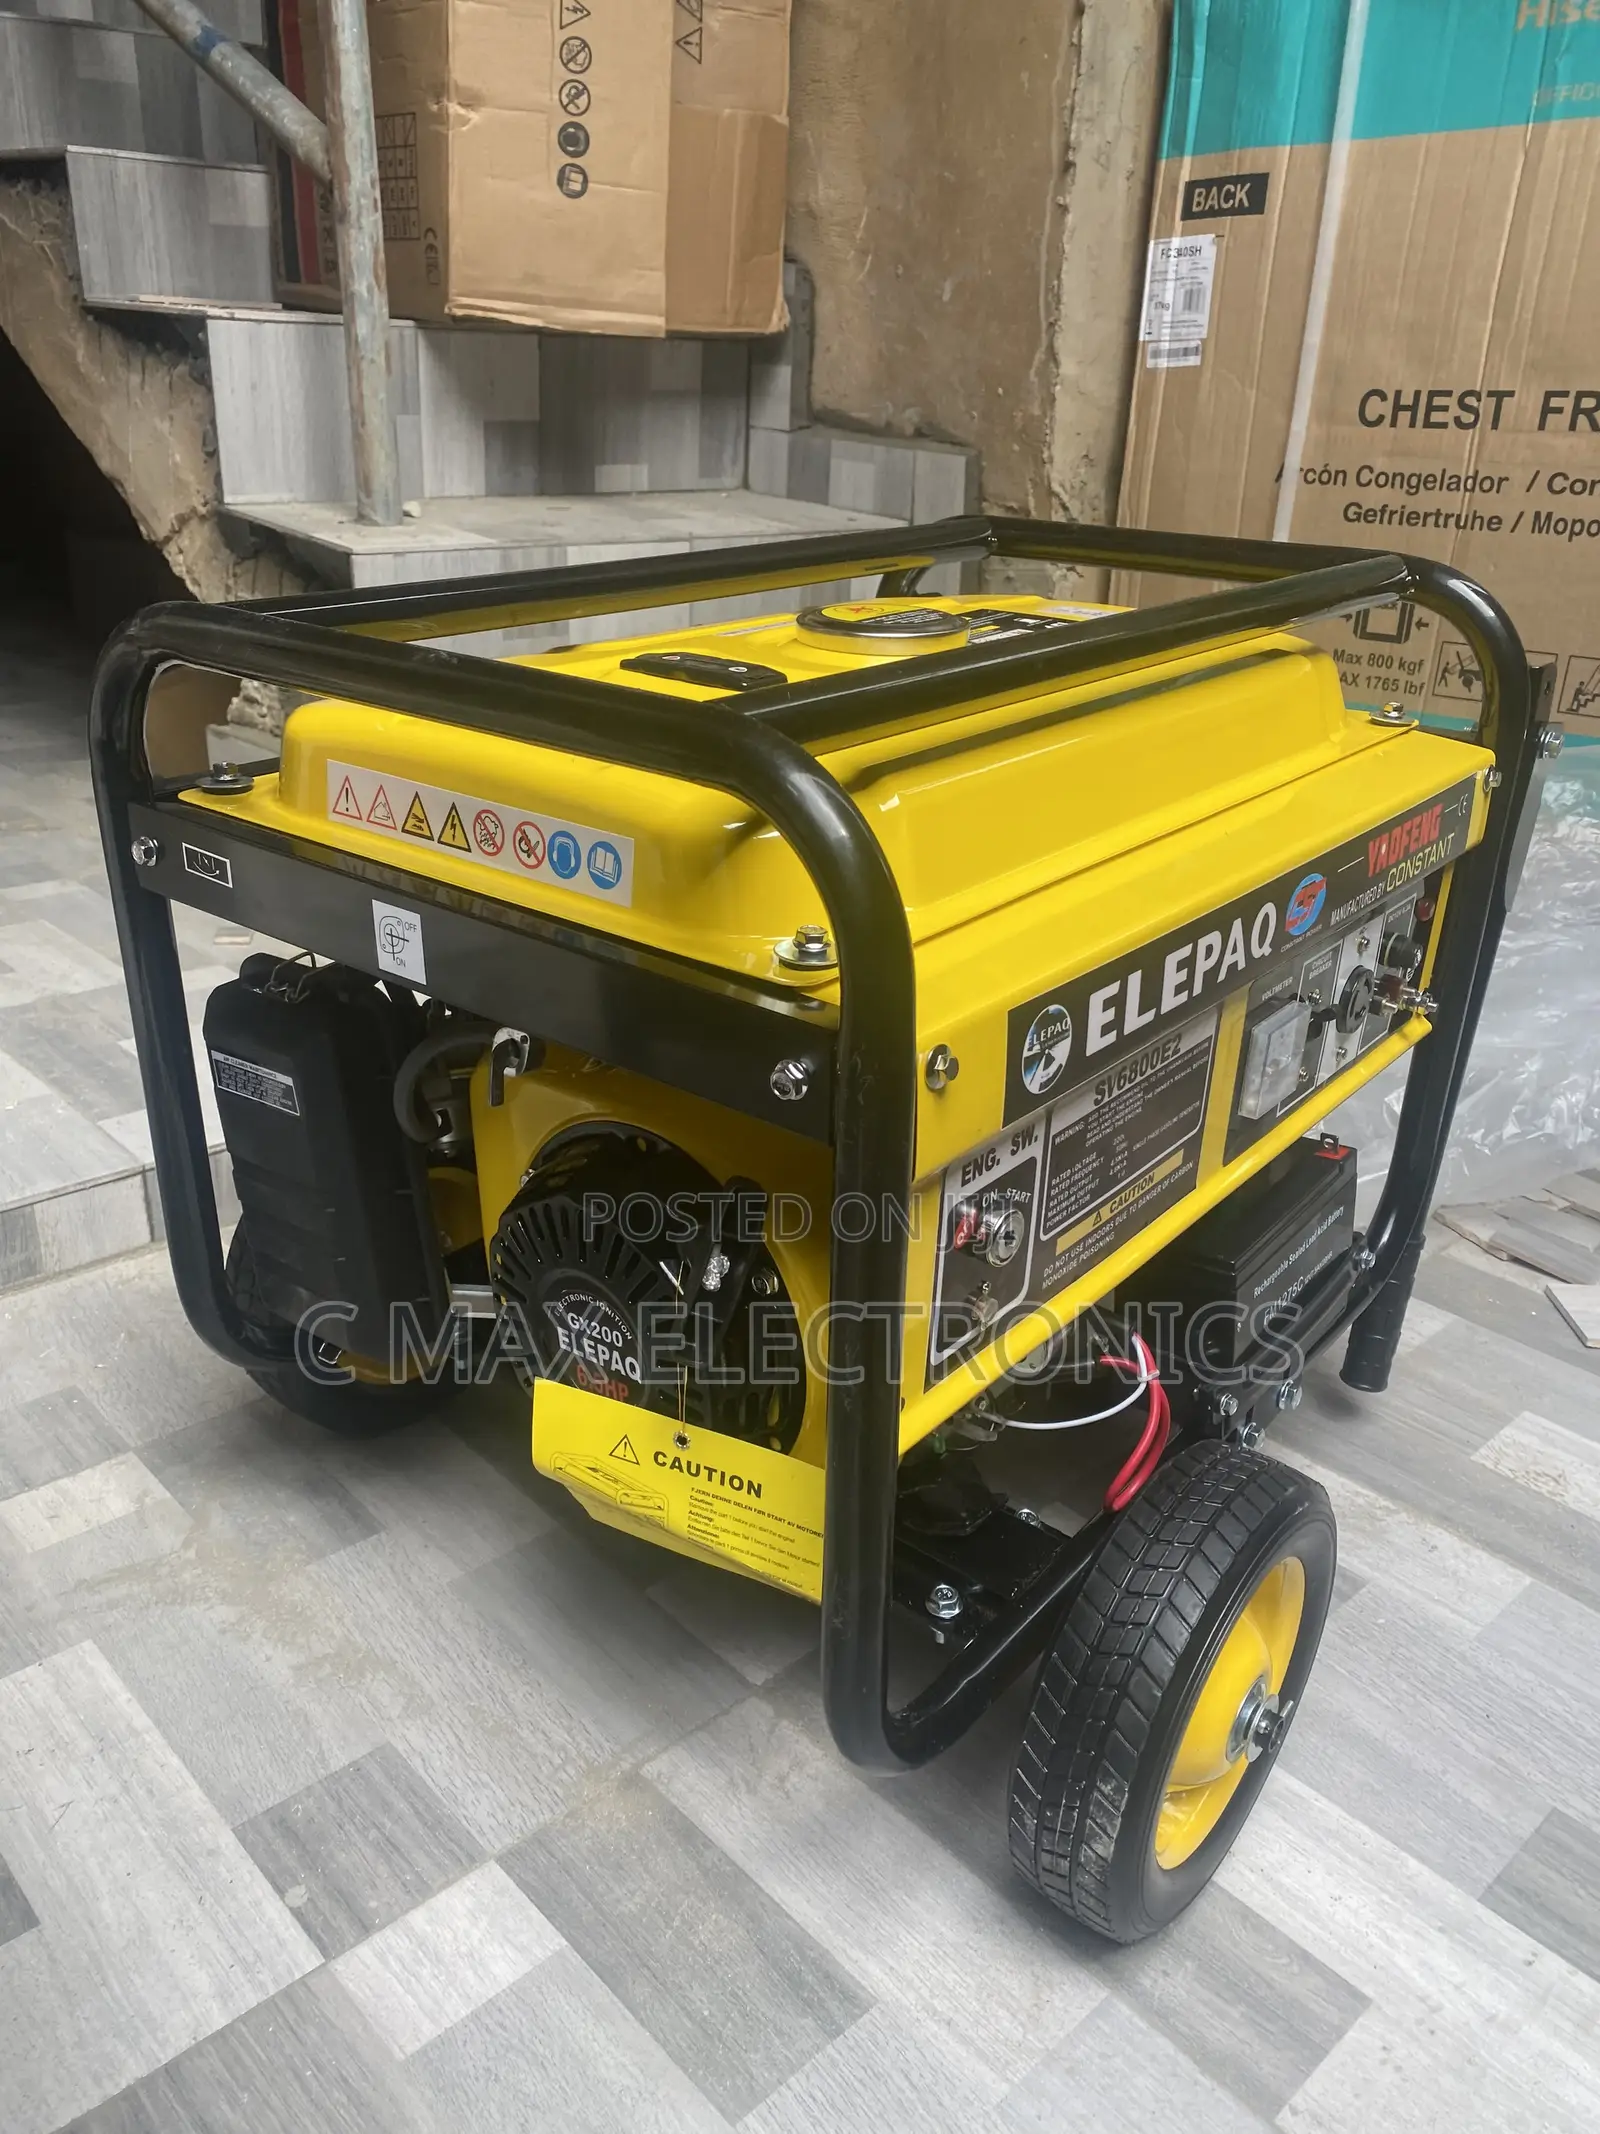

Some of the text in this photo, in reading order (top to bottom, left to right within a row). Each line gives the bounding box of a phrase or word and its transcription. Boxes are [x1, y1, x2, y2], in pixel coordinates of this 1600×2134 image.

[1192, 183, 1251, 212] BACK
[1358, 388, 1600, 432] CHEST FR
[1355, 464, 1509, 496] Congelador
[1526, 470, 1540, 493] /
[1343, 502, 1503, 532] Gefriertruhe
[1510, 511, 1524, 533] /
[1333, 648, 1425, 676] Max 800 kgf
[1339, 672, 1426, 697] AX 1765 lbf
[1330, 885, 1378, 927] MANUFACTURED
[1377, 881, 1387, 900] BY
[1386, 832, 1455, 892] CONSTANT
[404, 921, 418, 933] OFF
[395, 956, 407, 968] ON
[1085, 901, 1278, 1057] ELEPAQ
[1309, 960, 1333, 980] BREAKER
[1261, 976, 1294, 1001] VOLTMETER
[1093, 1032, 1183, 1107] SV6800E2
[960, 1122, 1039, 1188] ENG. SW.
[1049, 1191, 1069, 1209] RATED
[1069, 1173, 1094, 1195] OUTPUT
[1050, 1179, 1070, 1197] RATED
[1070, 1155, 1105, 1185] FREQUENCY
[1051, 1168, 1072, 1187] RATED
[1109, 1171, 1155, 1215] CAUTION
[982, 1187, 1032, 1208] ON START
[1046, 1208, 1068, 1229] POWER
[1067, 1193, 1091, 1215] FACTOR
[1047, 1194, 1077, 1219] MAXIMUM
[1076, 1177, 1100, 1199] OUTPUT
[1043, 1160, 1194, 1278] DO NOT USE INDOORS DUE TO DANGER OF CARBON
[1042, 1231, 1116, 1291] MONOXIDE POISONING
[1253, 1205, 1344, 1299] Rechargeable Sealed Lead Acid Battery
[554, 1293, 633, 1340] ELECTRONIC IGNITION
[567, 1312, 623, 1348] GX200
[556, 1326, 642, 1384] ELEPAQ
[653, 1450, 762, 1499] CAUTION
[733, 1500, 753, 1512] DELEN
[767, 1512, 786, 1524] START
